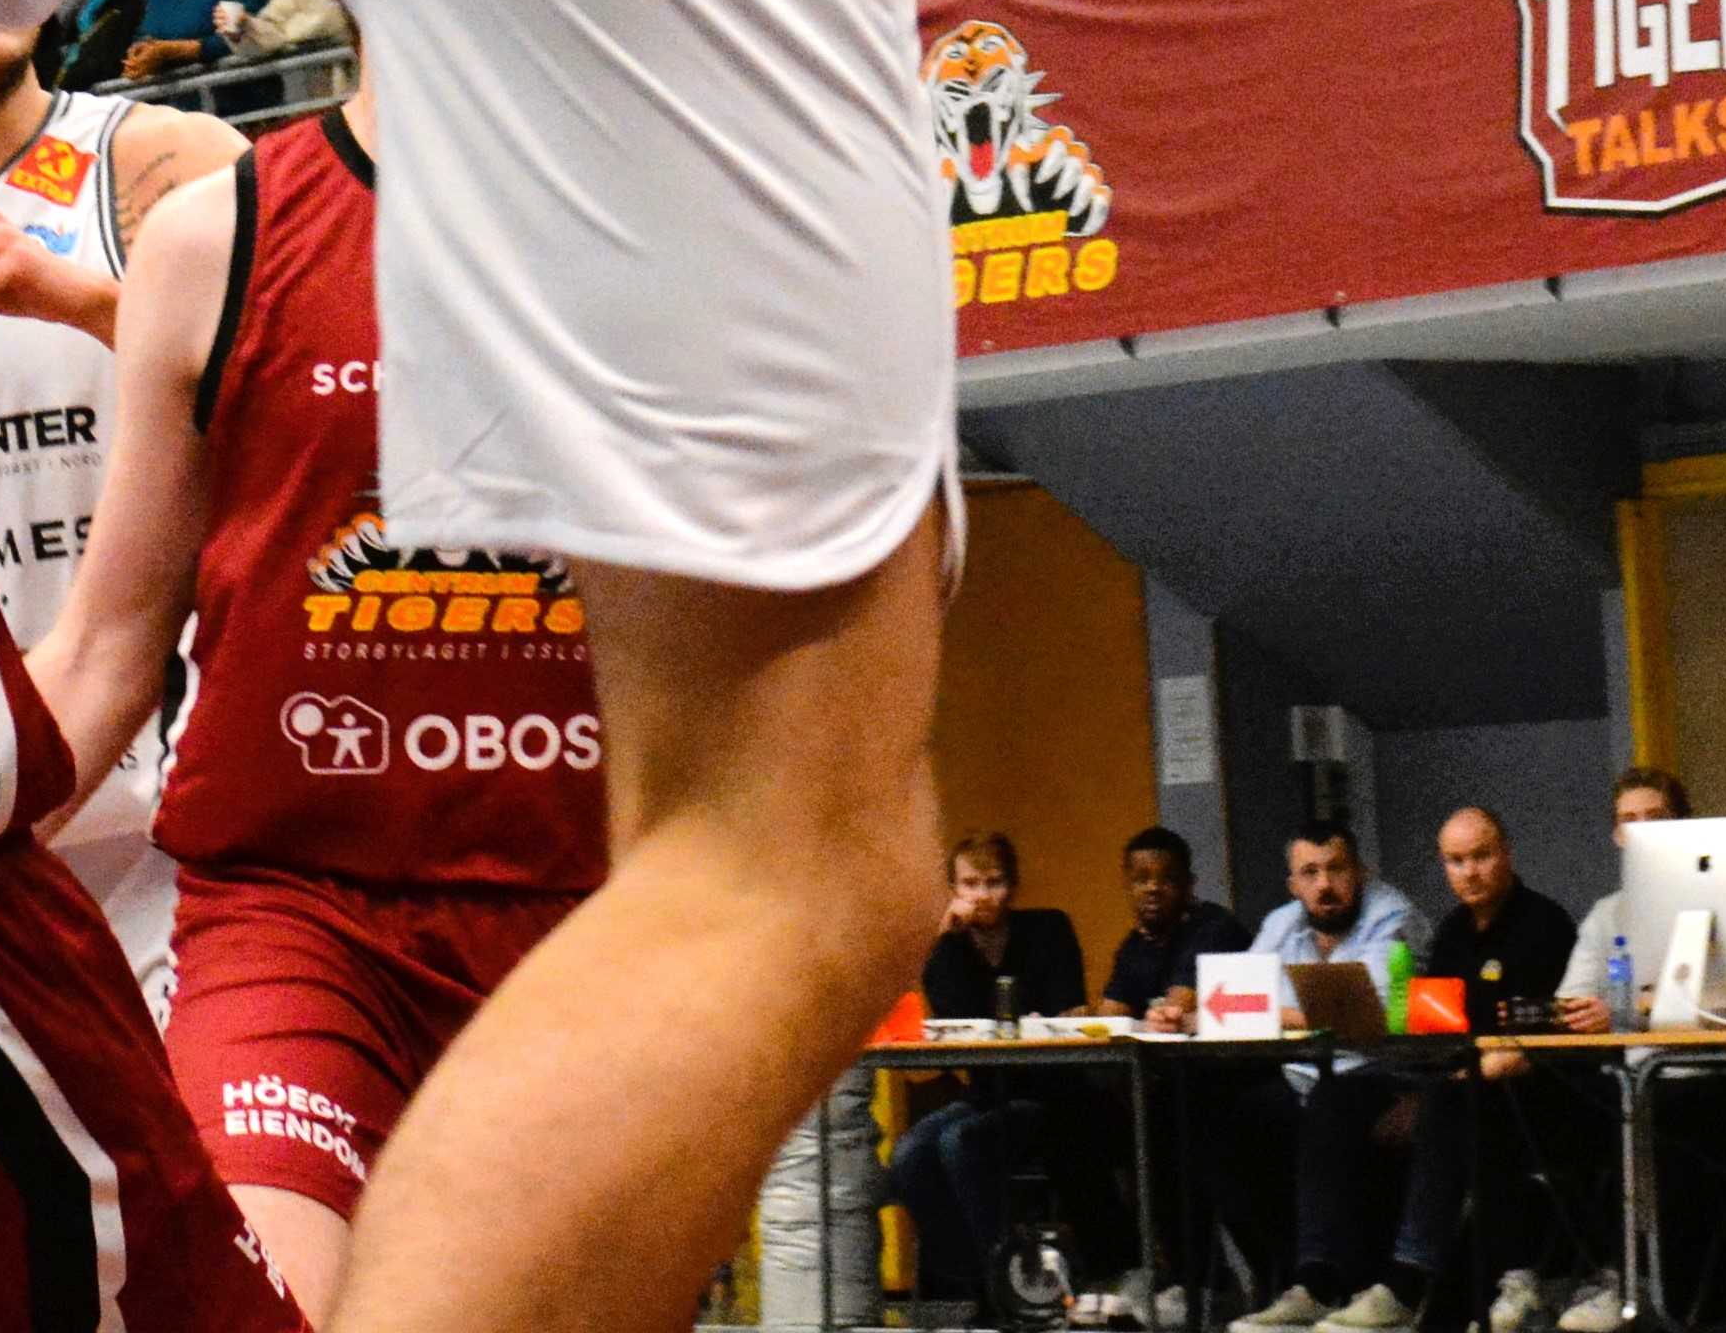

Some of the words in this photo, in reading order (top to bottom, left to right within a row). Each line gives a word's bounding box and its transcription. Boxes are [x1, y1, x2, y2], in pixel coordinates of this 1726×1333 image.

[302, 594, 586, 633] TIGERS
[303, 641, 488, 662] STORBYLAGET
[522, 642, 588, 663] OSLO
[404, 713, 602, 772] OBOS
